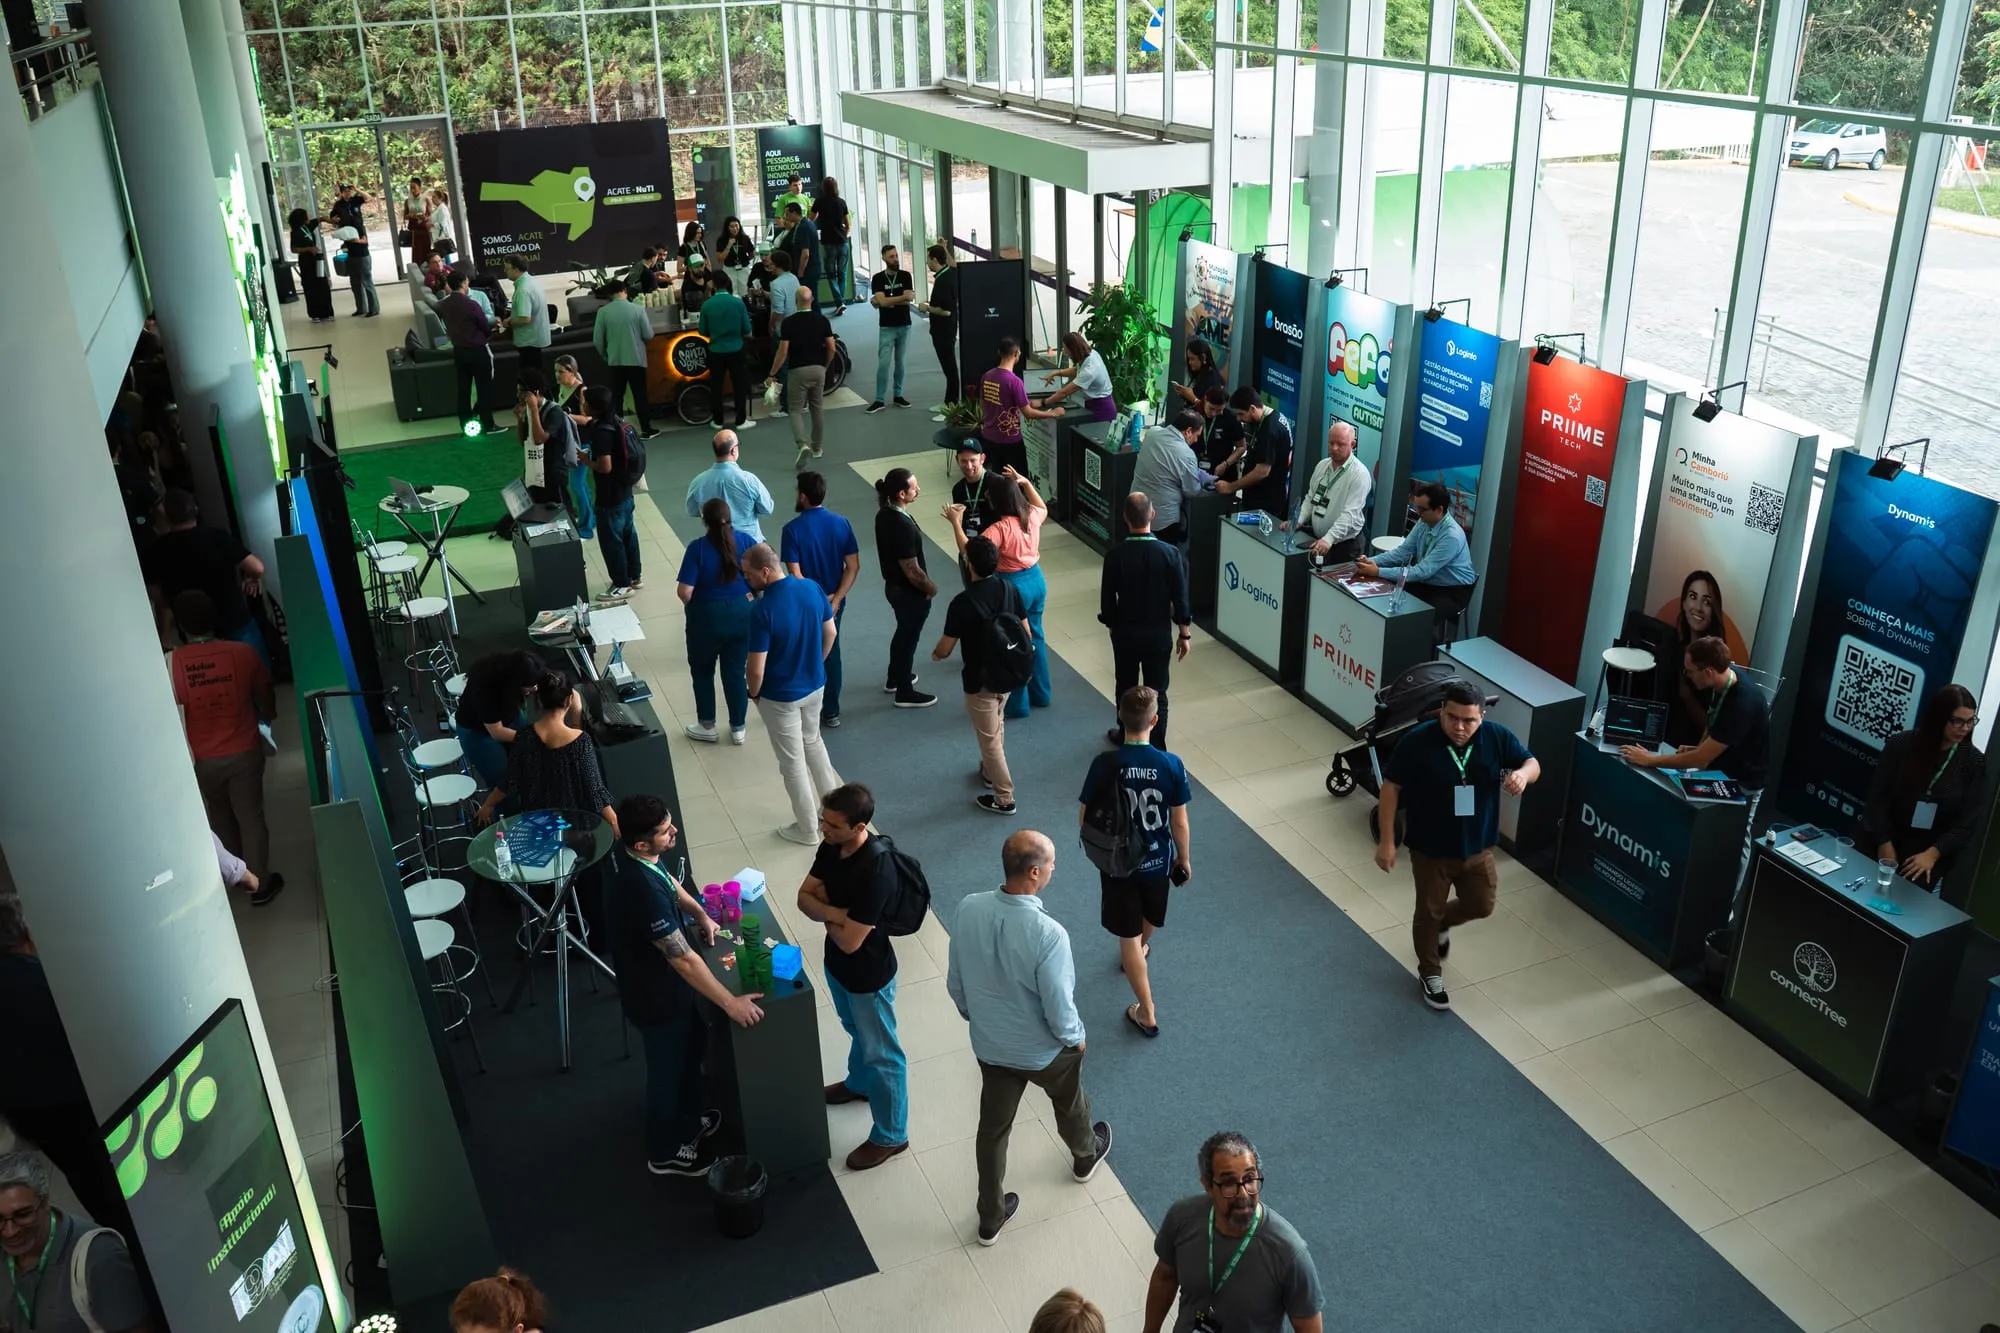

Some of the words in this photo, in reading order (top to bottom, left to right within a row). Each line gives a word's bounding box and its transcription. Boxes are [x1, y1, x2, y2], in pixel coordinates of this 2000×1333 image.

[765, 150, 781, 158] AQUI
[766, 156, 794, 164] PESSOAS
[767, 164, 805, 172] TECNOLOGIA
[607, 186, 631, 196] ACATE
[482, 234, 512, 245] SOMOS
[518, 232, 544, 240] ACATE
[484, 247, 496, 256] NA
[497, 243, 527, 254] REGIÃO
[528, 242, 541, 252] DA
[1274, 316, 1303, 340] brasão
[678, 346, 708, 368] SANTA
[1456, 347, 1477, 360] Loginfo
[686, 357, 707, 372] BIKE
[1424, 360, 1441, 371] GESTÃO
[1442, 366, 1473, 384] OPERACIONAL
[1267, 375, 1295, 393] ESPECIALIZADA
[1268, 367, 1294, 385] CONSULTORIA
[1424, 368, 1436, 378] PARA
[1440, 375, 1449, 383] SEU
[1450, 378, 1469, 392] RECINTO
[1423, 378, 1456, 395] ALFANDEGADO
[1541, 408, 1605, 448] PRIIME
[1560, 436, 1581, 450] TECH
[1691, 451, 1716, 466] Minha
[1536, 470, 1556, 484] EMPRESA
[1690, 460, 1729, 481] Camboriú
[1672, 474, 1695, 490] Muito
[1696, 484, 1716, 498] mais
[1716, 492, 1733, 505] que
[1668, 495, 1714, 520] movimento
[1670, 485, 1687, 498] uma
[1688, 491, 1720, 512] startup,
[1720, 506, 1735, 517] um
[1888, 504, 1936, 530] Dynamis
[1242, 577, 1278, 610] Loginfo
[1847, 598, 1902, 628] CONHEÇA
[1904, 622, 1936, 642] MAIS
[1846, 611, 1877, 632] SOBRE
[1877, 626, 1886, 635] A
[1886, 628, 1930, 655] DYNAMIS
[1312, 633, 1376, 690] PRIIME
[1332, 668, 1353, 688] TECH
[1580, 803, 1672, 878] Dynamis
[1602, 870, 1616, 883] NOVA
[1769, 967, 1848, 1029] connecTree
